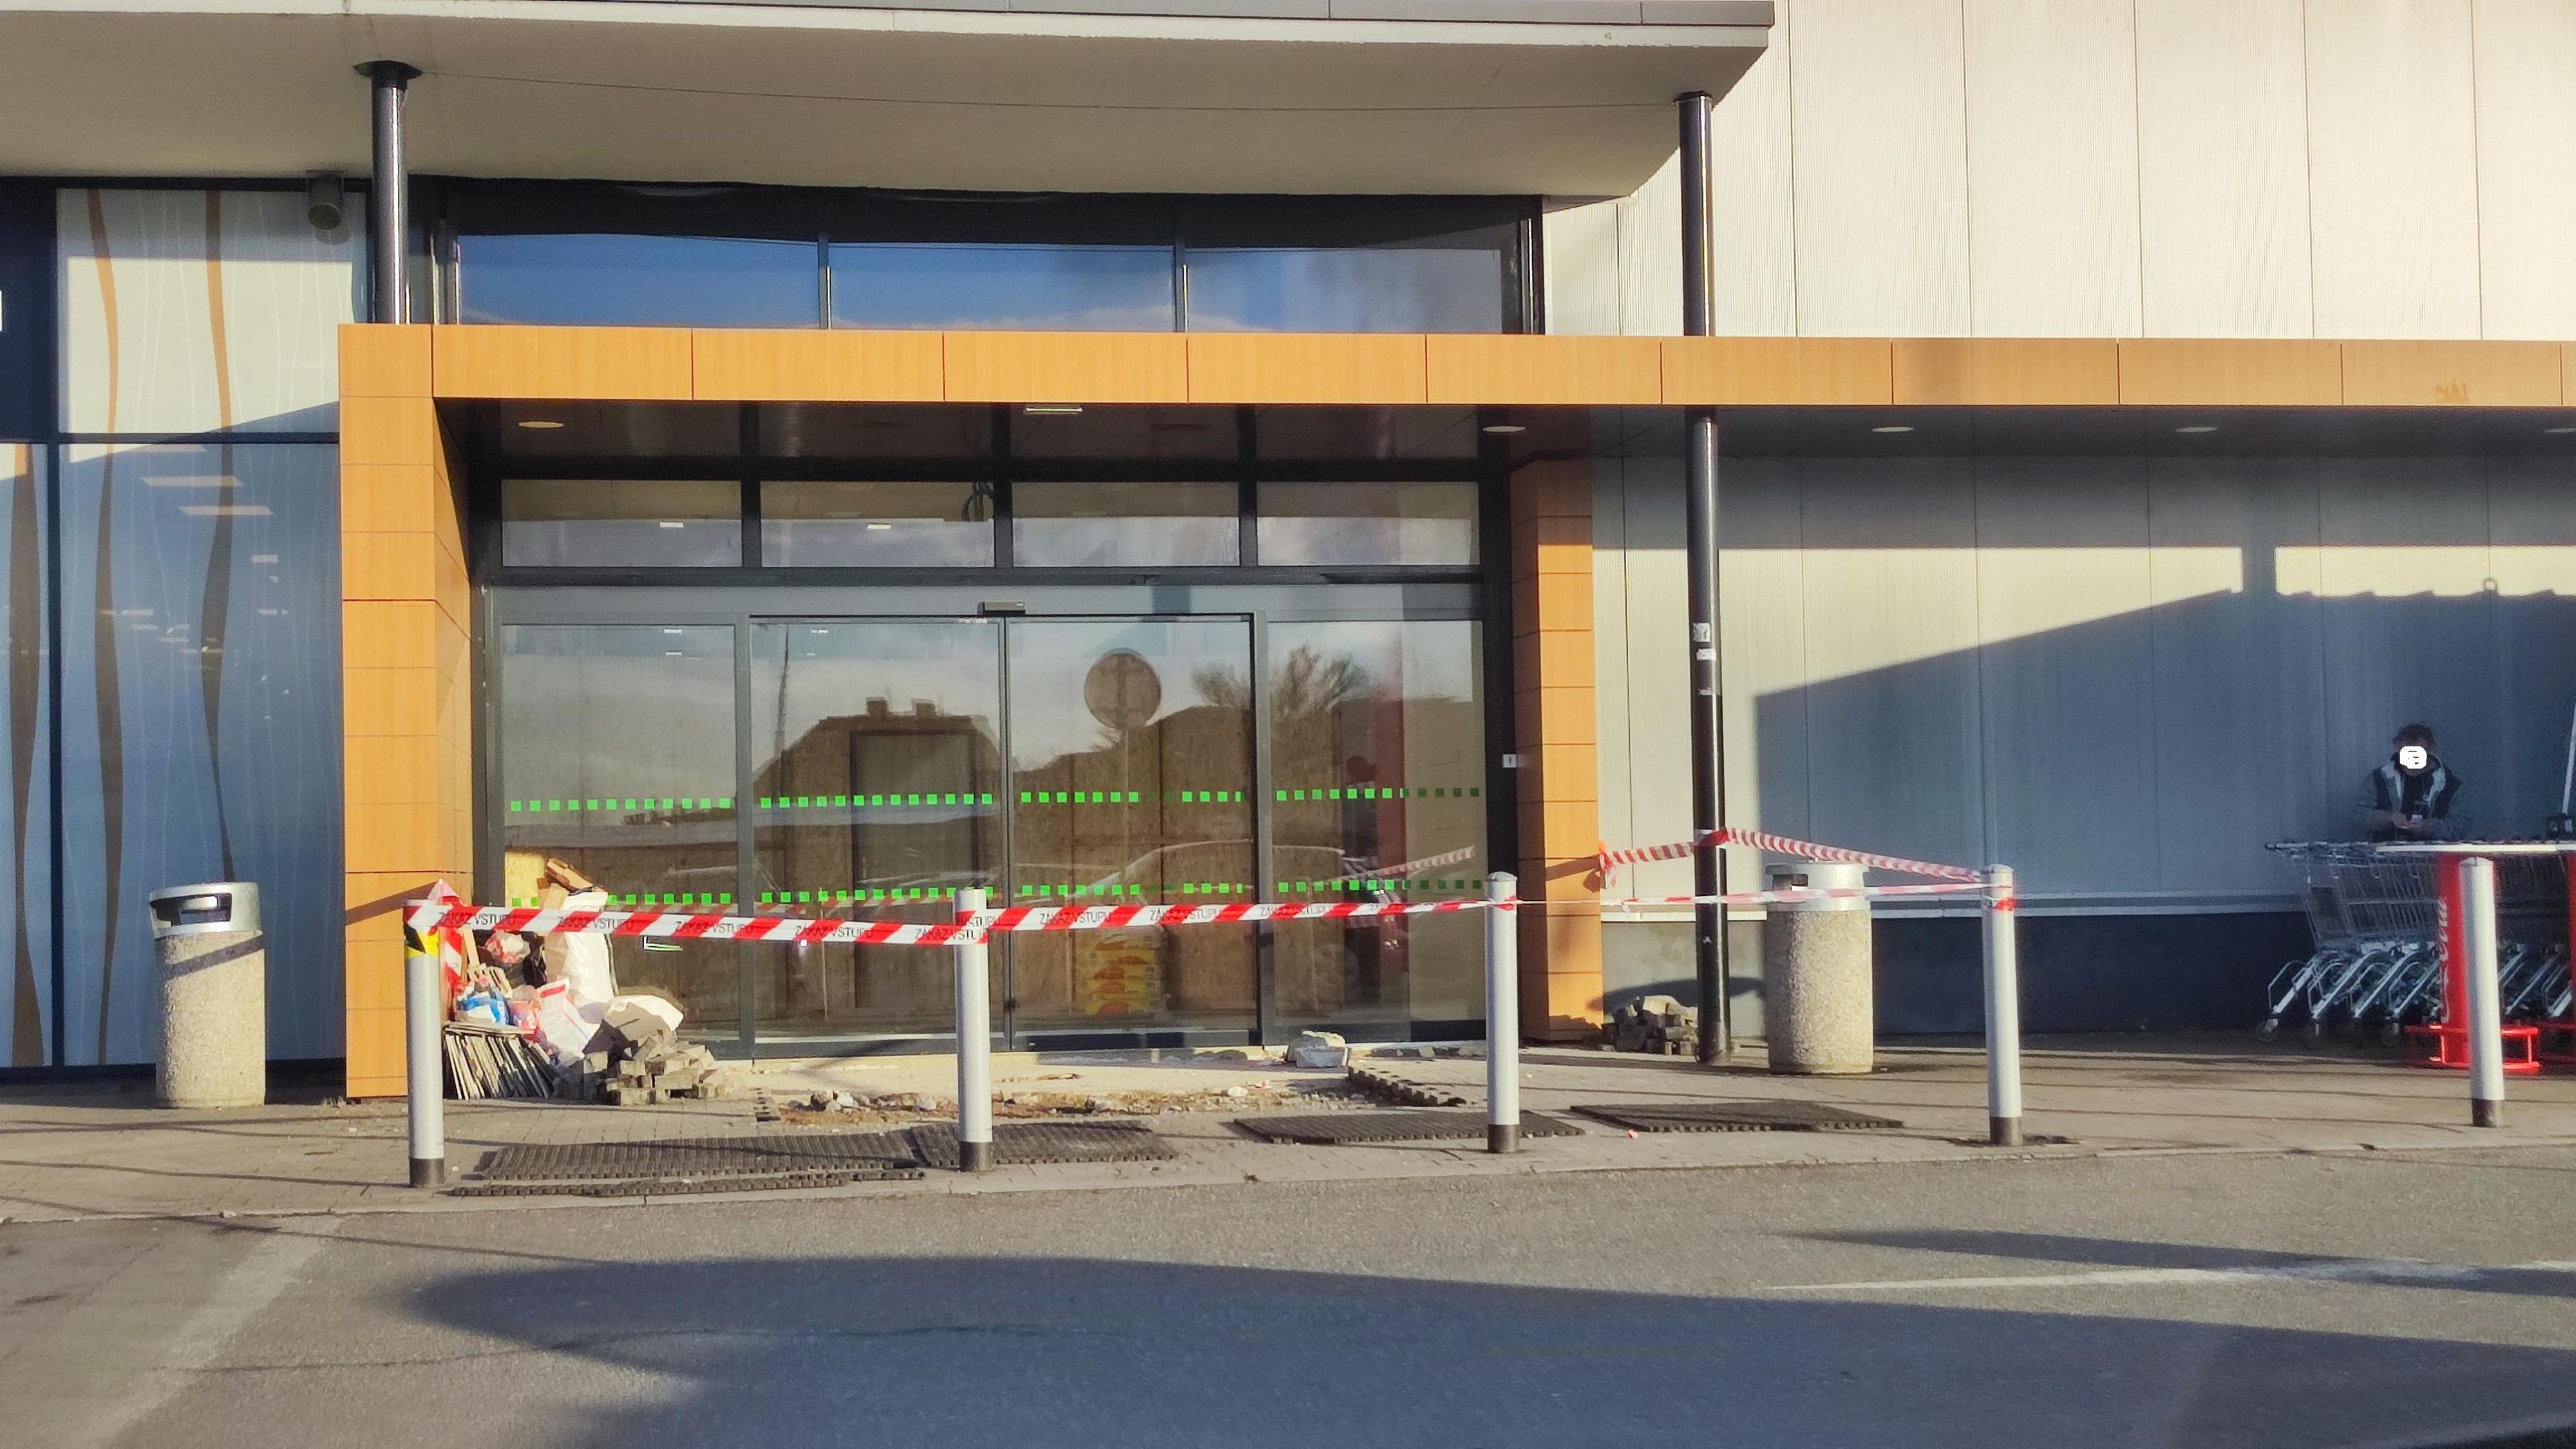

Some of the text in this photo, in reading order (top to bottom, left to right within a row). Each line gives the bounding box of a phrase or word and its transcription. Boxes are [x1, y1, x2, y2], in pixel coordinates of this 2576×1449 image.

[438, 912, 515, 925] ZAKAZ VSTUPU
[557, 916, 634, 930] ZAKAZ VSTUPU
[1039, 911, 1112, 924] ZAKAZ VSTUPU
[675, 921, 753, 934] ZAKAZ VSTUPU
[831, 927, 873, 938] VSTUPU
[915, 928, 950, 939] ZAKAZ
